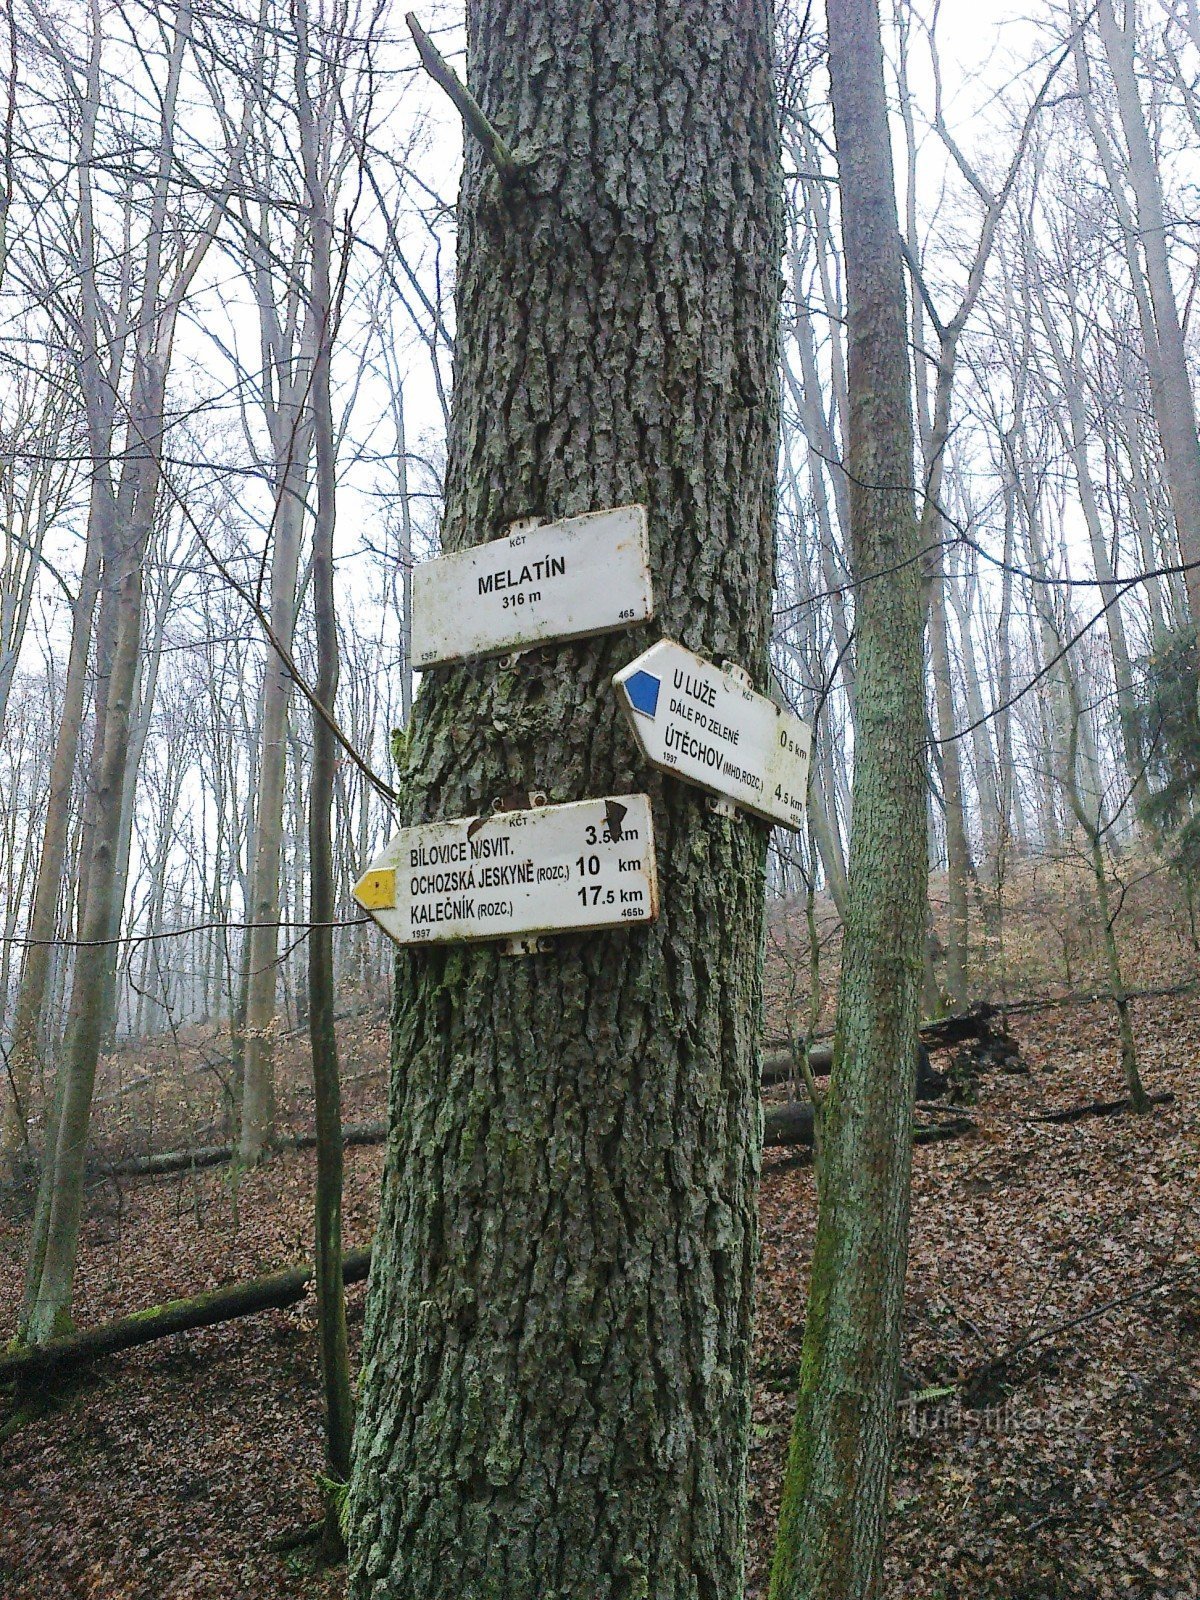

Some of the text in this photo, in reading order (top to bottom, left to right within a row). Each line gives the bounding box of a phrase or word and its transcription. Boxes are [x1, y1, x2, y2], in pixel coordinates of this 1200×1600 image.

[509, 535, 527, 549] KČT
[478, 555, 565, 595] MELATÍN
[502, 591, 542, 609] 316 m
[618, 608, 635, 619] 465
[673, 668, 717, 708] U LUŽE
[670, 698, 740, 746] DÁLE PO ZELENÉ
[665, 723, 724, 770] ÚTĚCHOV
[795, 743, 807, 760] km
[774, 783, 803, 812] 4.5 km
[509, 816, 528, 828] KČT
[585, 825, 611, 846] 3.5
[410, 842, 467, 868] BÍLOVICE
[575, 855, 641, 877] 10 km
[410, 859, 570, 896] OCHOZSKÁ JESKYNĚ (ROZC.)
[577, 885, 644, 908] 17.5 km
[410, 896, 513, 925] KALEČNÍK (ROZC.)
[621, 907, 644, 917] 465b
[411, 928, 431, 939] 1997
